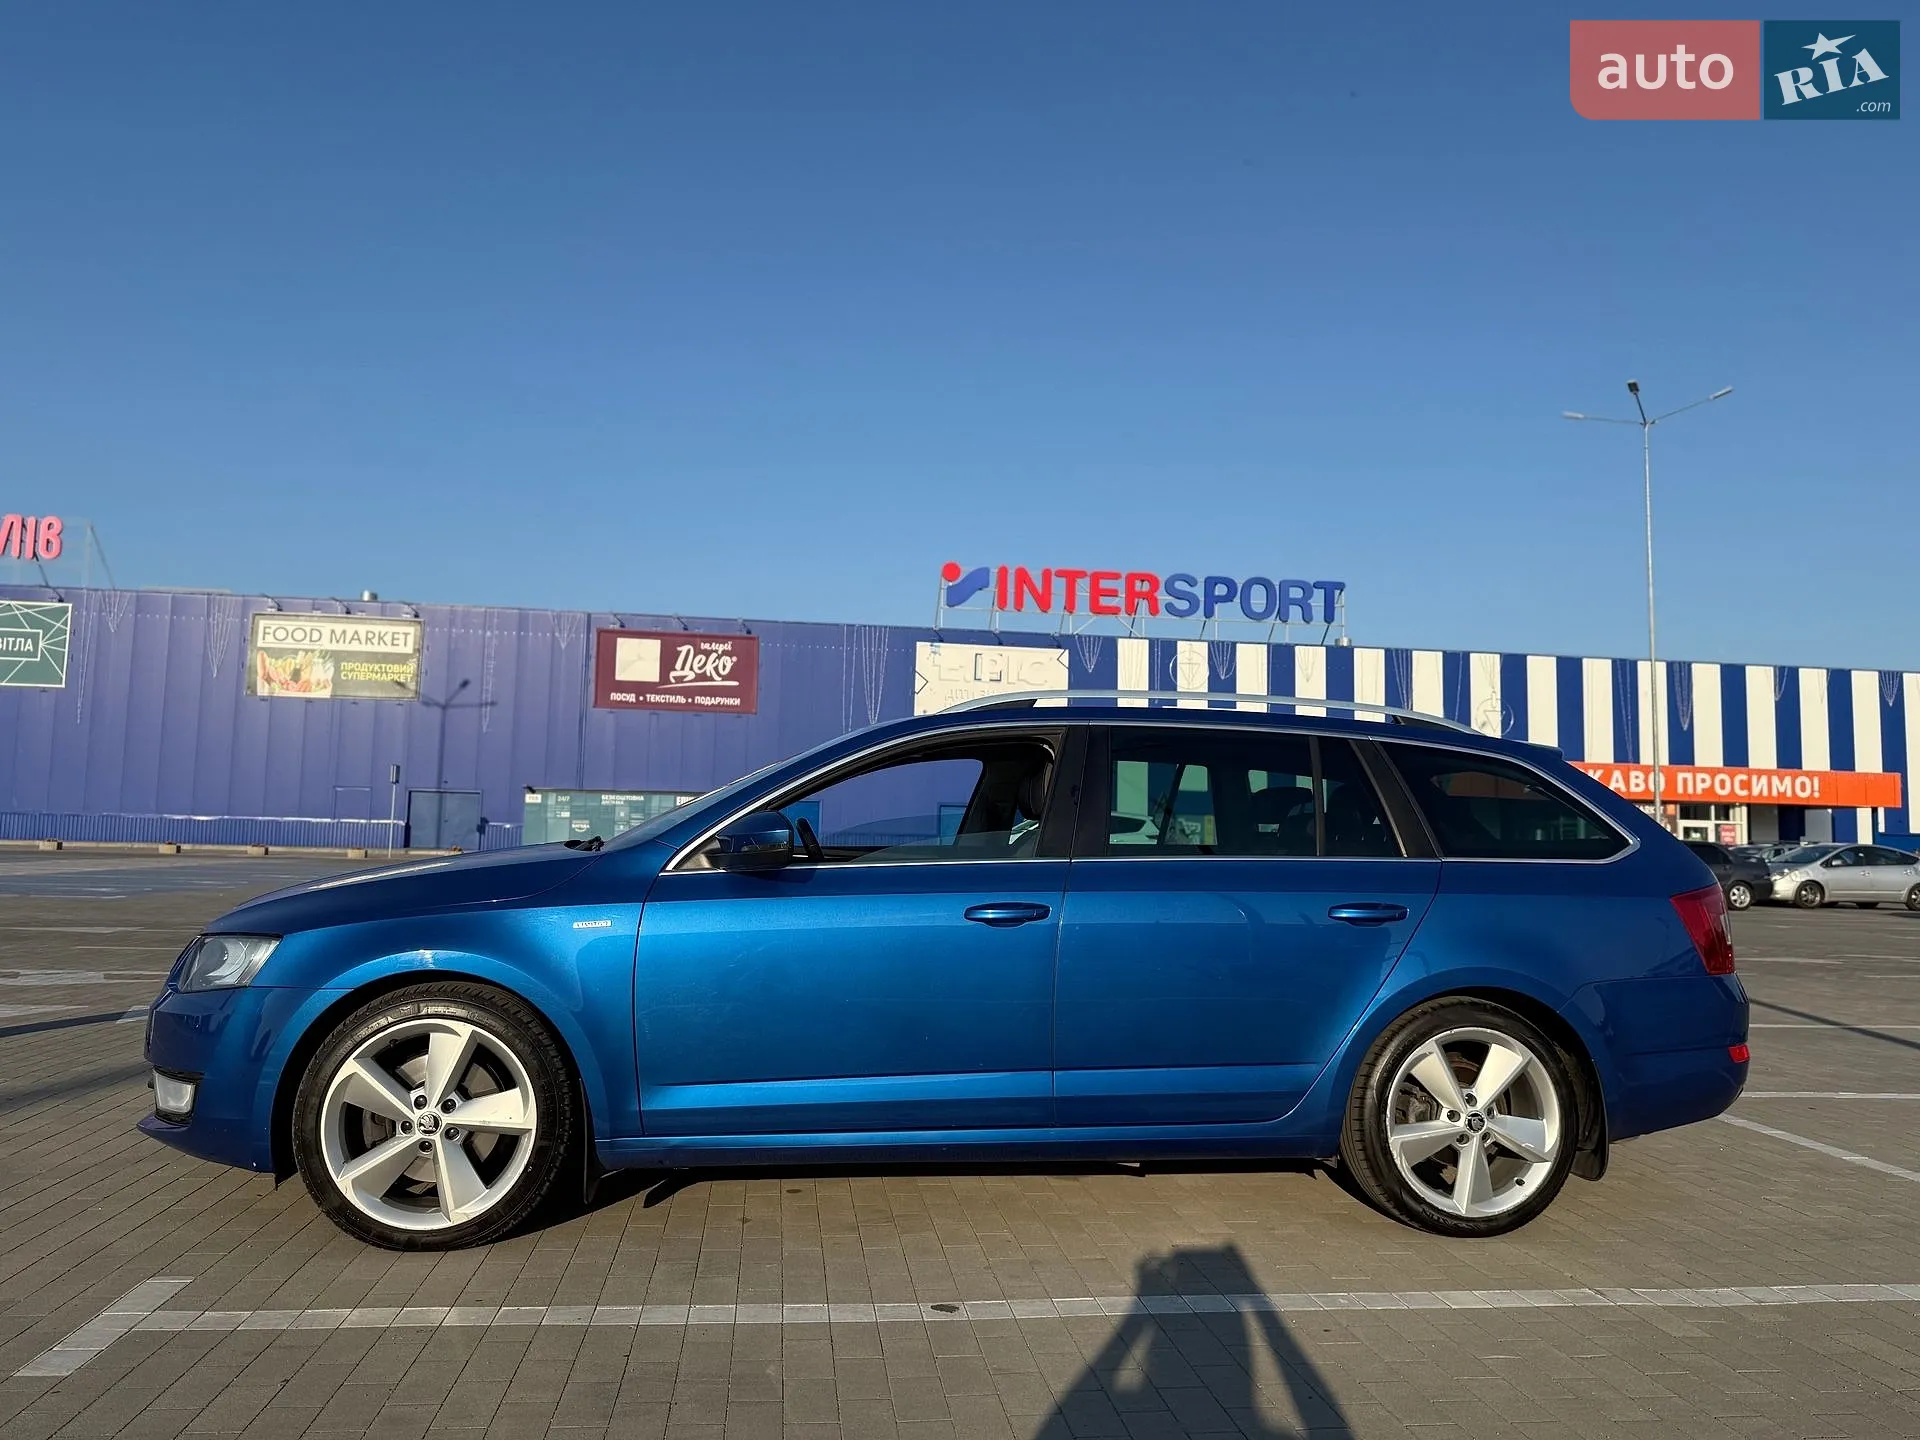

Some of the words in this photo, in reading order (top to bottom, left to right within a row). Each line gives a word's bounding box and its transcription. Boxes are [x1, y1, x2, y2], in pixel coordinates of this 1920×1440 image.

[996, 565, 1346, 624] INTERSPORT
[262, 626, 322, 643] FOOD
[329, 629, 411, 648] MARKET
[669, 644, 734, 684] Деко
[340, 671, 413, 683] СУПЕРМАРКЕТ
[610, 692, 636, 703] ПОСУД
[646, 694, 686, 704] ТЕКСТИЛЬ
[694, 697, 741, 706] ПОДАРУНКИ
[1676, 772, 1820, 799] ПРОСИМО!
